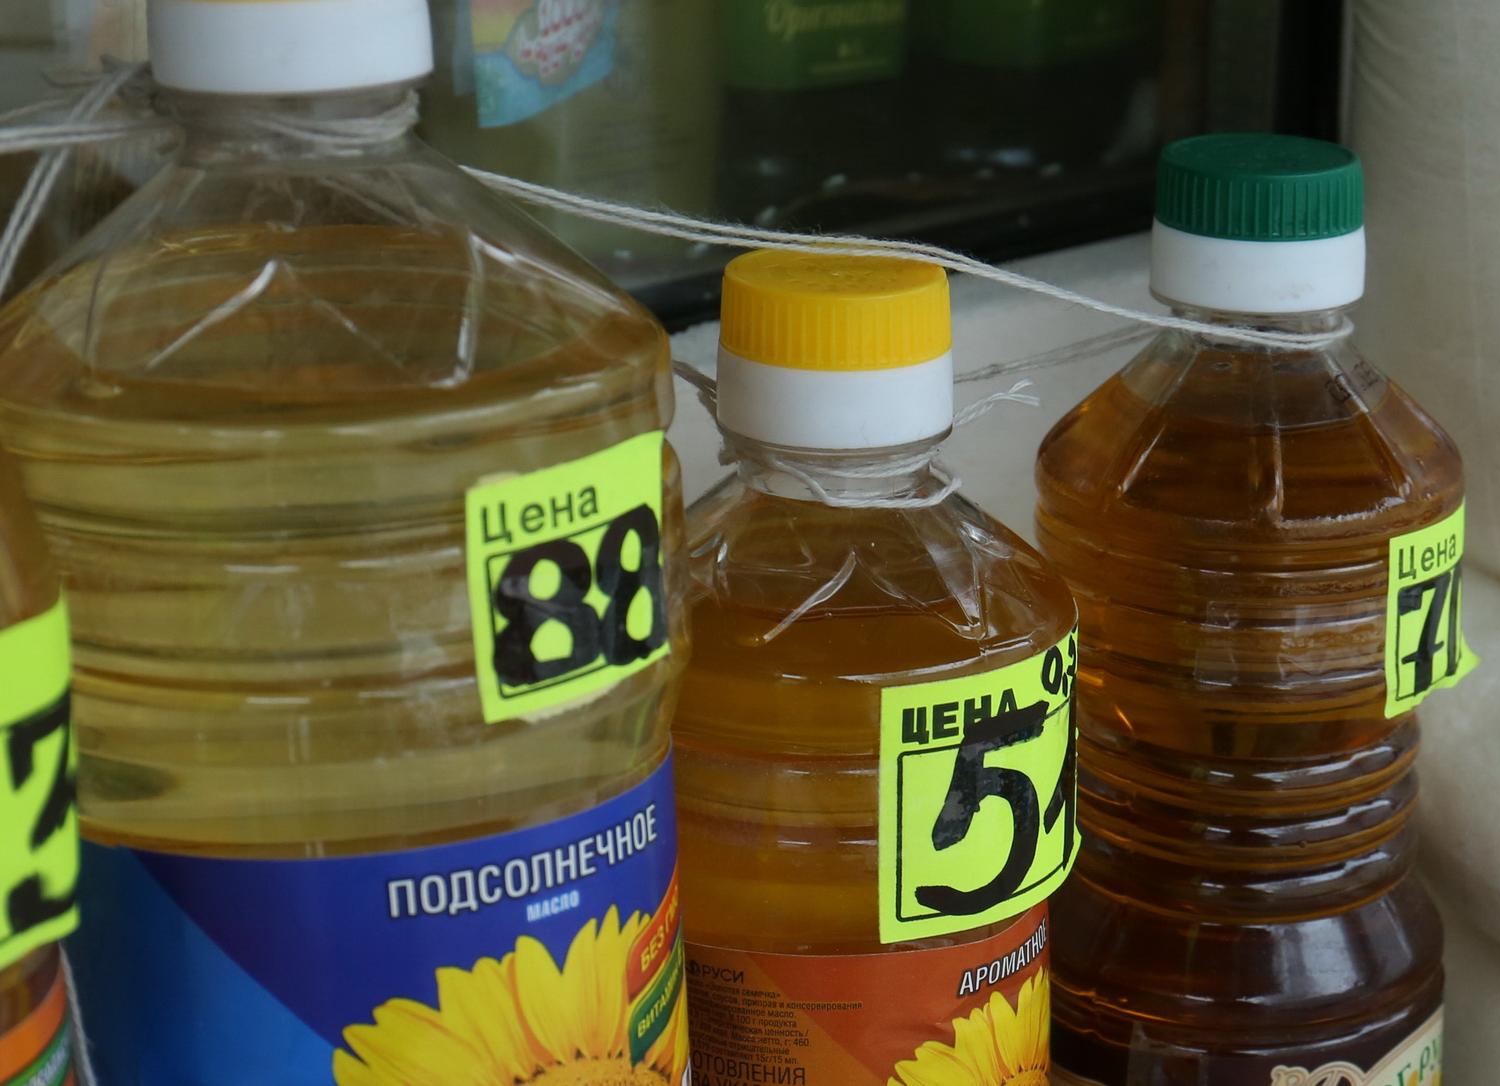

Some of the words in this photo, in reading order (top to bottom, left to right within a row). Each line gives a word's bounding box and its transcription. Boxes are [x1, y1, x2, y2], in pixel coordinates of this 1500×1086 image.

[481, 484, 599, 544] Цена
[1397, 533, 1457, 580] Цена
[493, 504, 669, 688] 88
[902, 688, 1021, 745] ЦЕНА
[387, 804, 658, 918] ПОДСОЛНЕЧНОЕ
[526, 889, 580, 922] МАСЛО
[786, 1001, 863, 1013] консервирования
